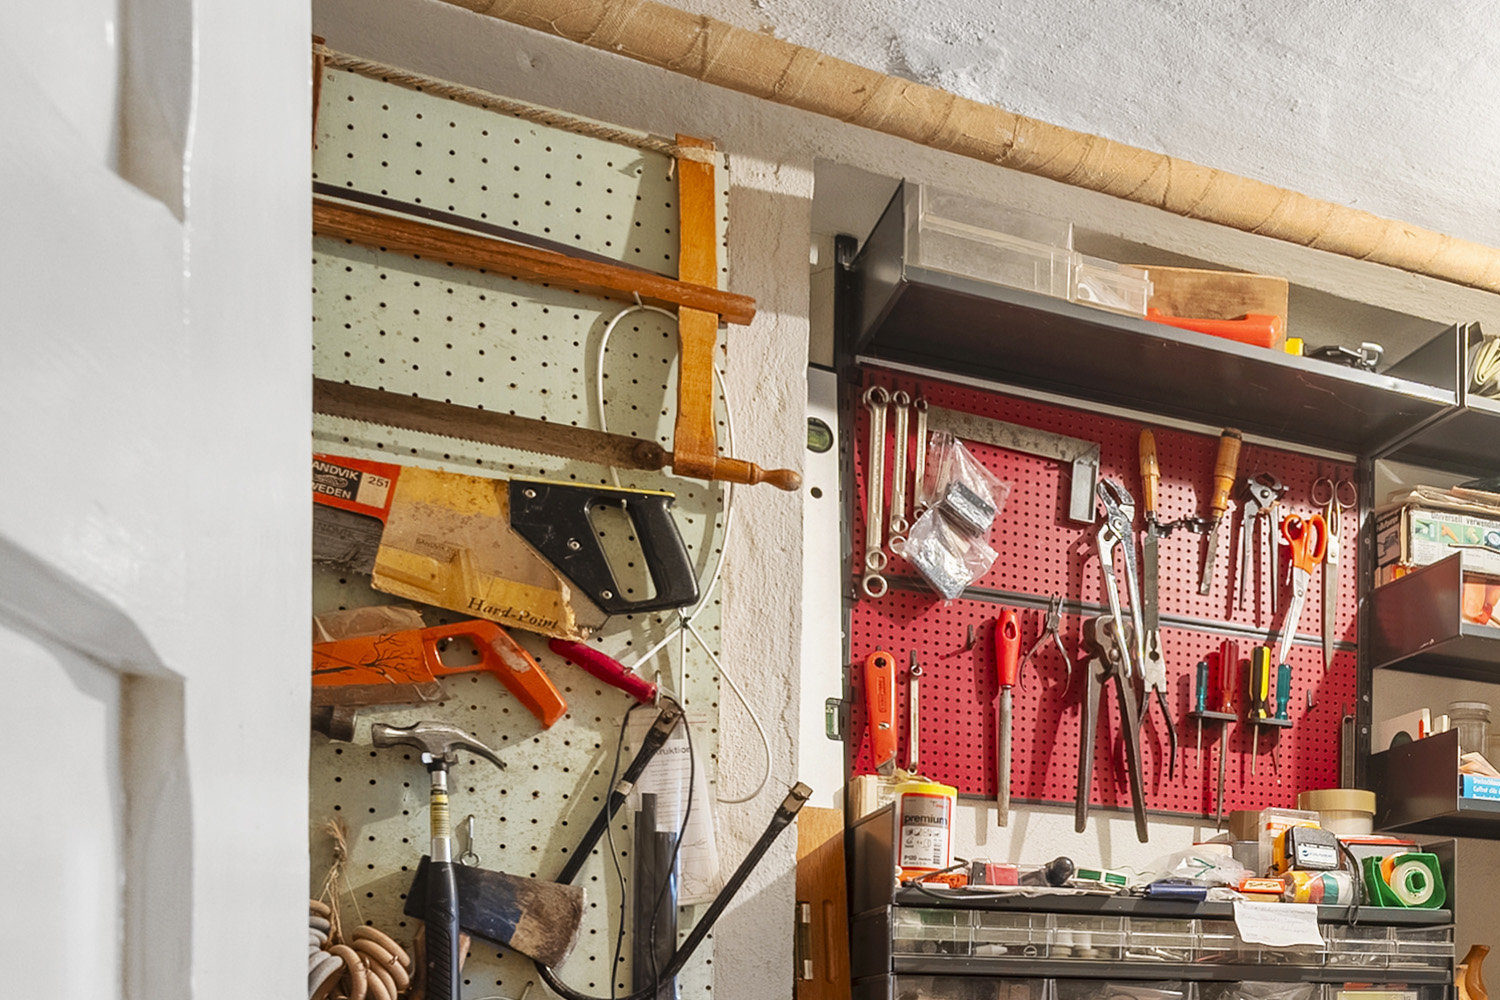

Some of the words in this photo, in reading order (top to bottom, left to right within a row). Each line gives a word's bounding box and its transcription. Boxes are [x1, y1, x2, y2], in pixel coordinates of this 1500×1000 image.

[312, 460, 359, 481] ANDVIK
[312, 482, 351, 499] EDEN
[368, 476, 390, 489] 251
[467, 596, 559, 630] Hard-Point
[904, 815, 948, 825] premium
